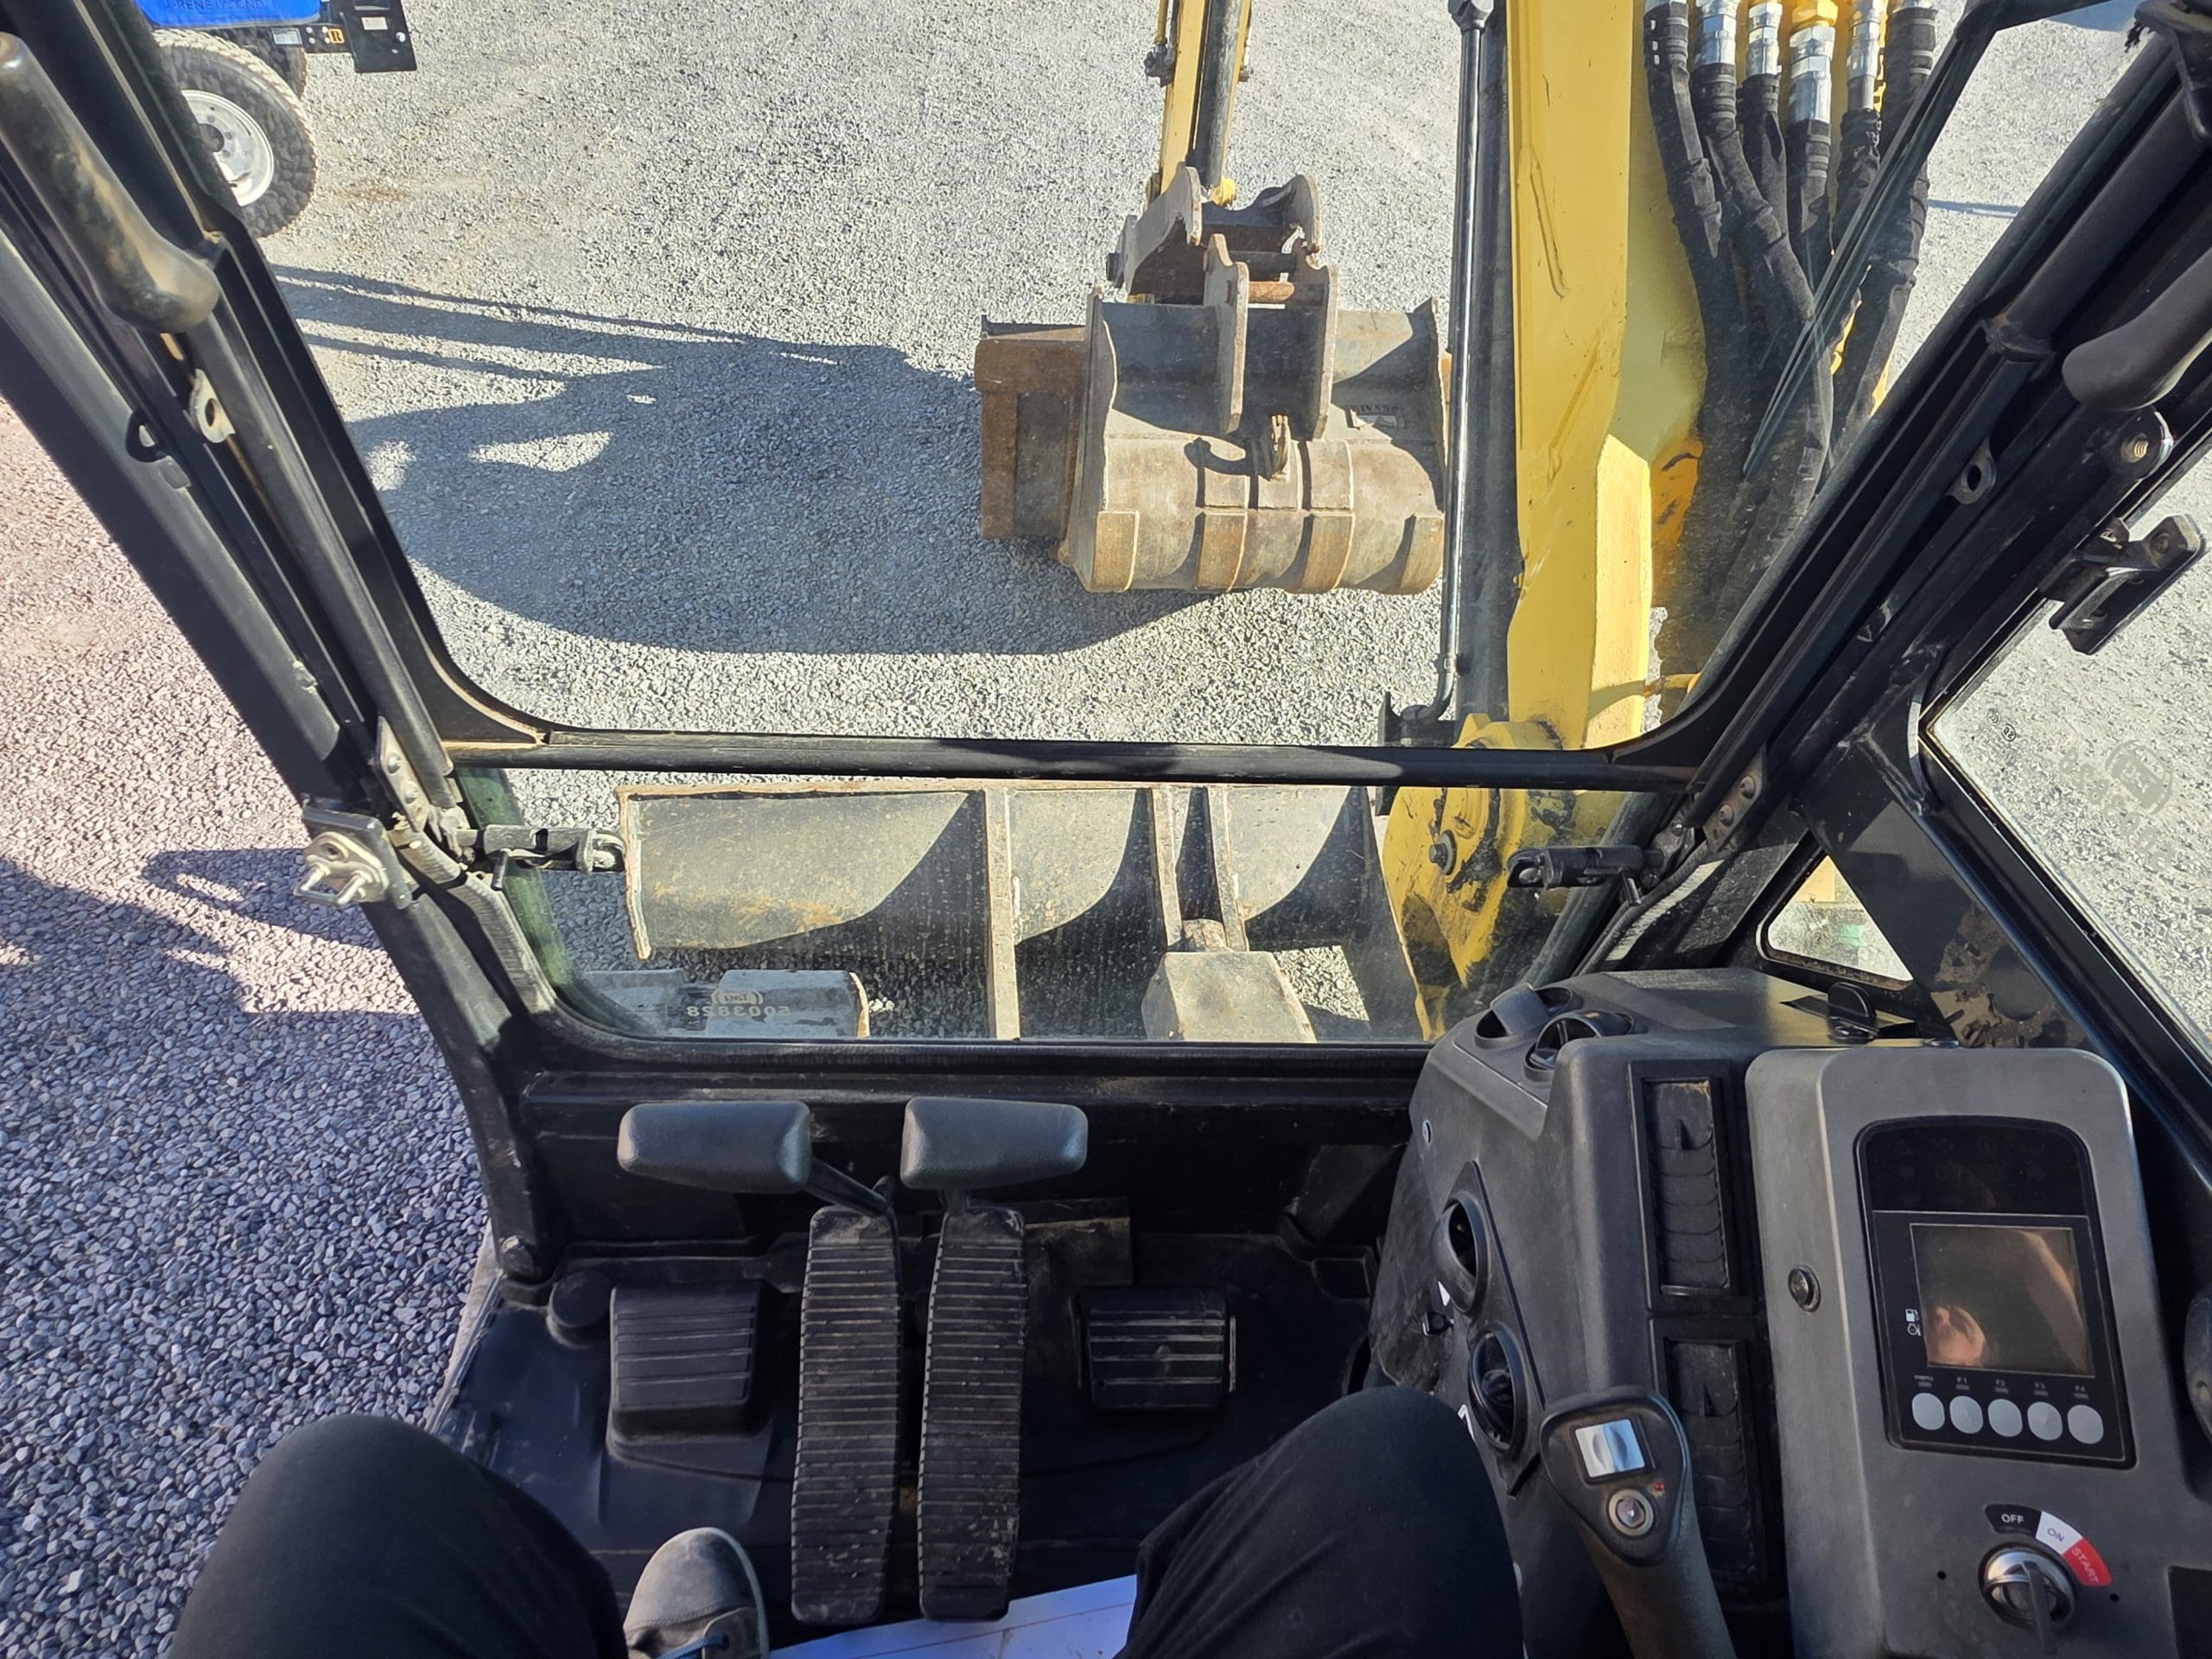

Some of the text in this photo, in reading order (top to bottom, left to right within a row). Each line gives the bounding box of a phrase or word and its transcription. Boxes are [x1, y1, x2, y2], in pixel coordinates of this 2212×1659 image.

[2001, 1514, 2024, 1523] OFF
[2047, 1528, 2065, 1542] ON
[2071, 1547, 2100, 1583] START
